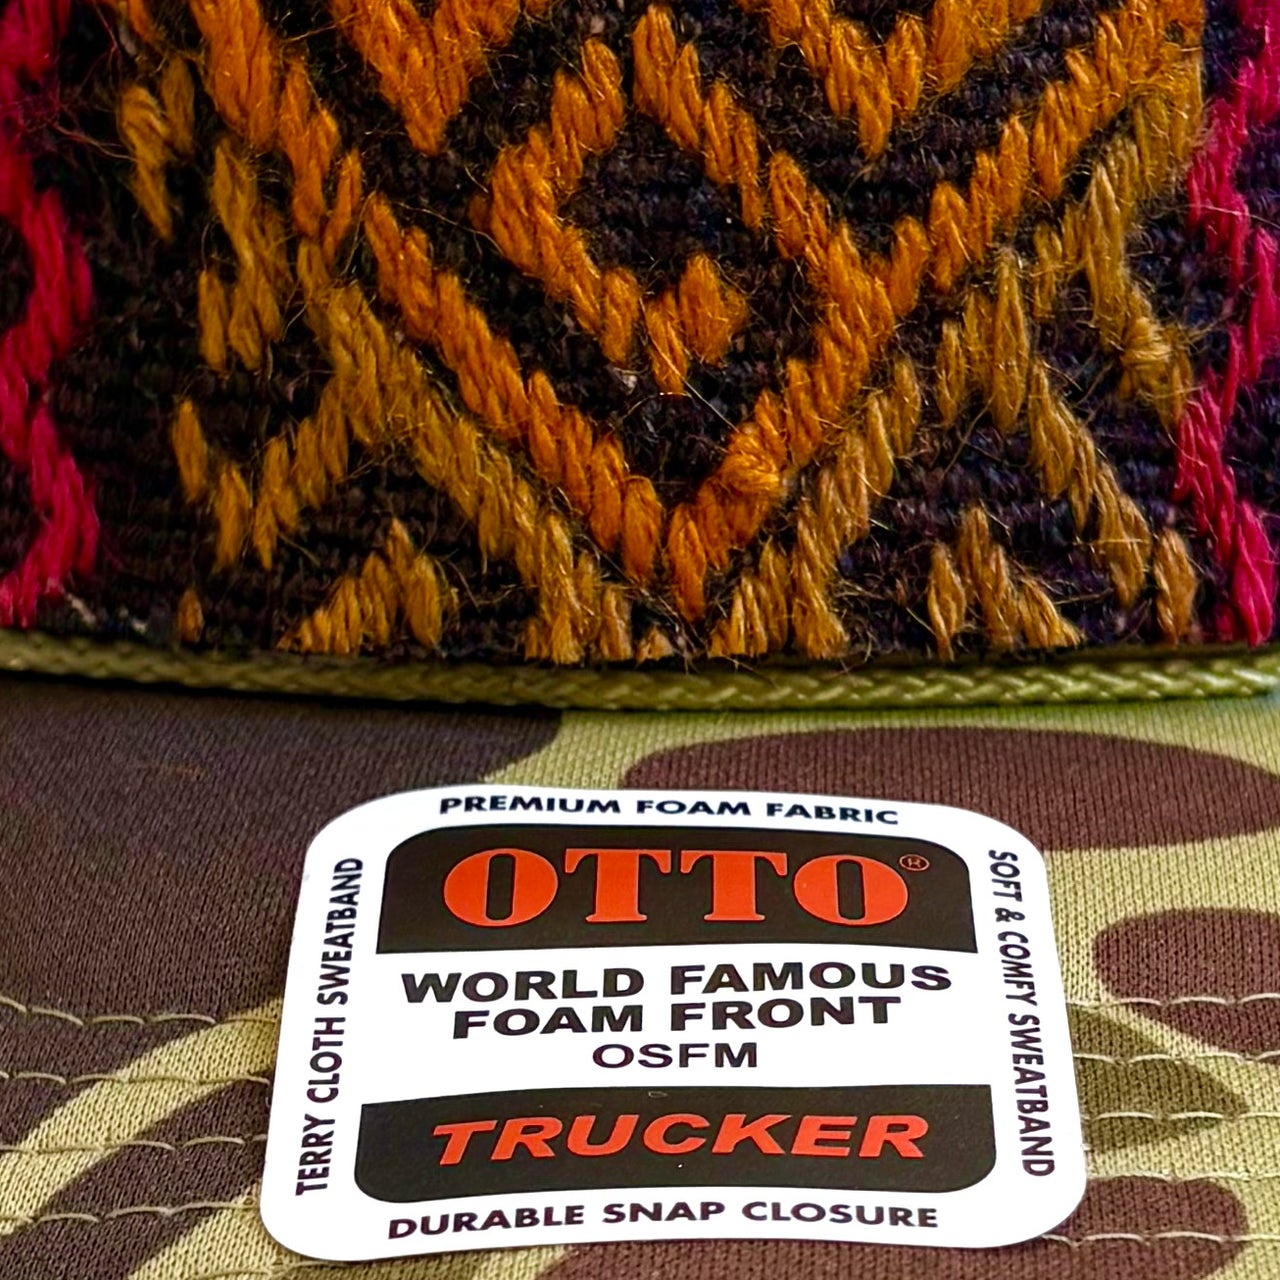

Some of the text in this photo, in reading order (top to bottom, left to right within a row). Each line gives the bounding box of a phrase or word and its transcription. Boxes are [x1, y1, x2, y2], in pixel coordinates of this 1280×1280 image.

[440, 796, 899, 825] PREMIUM FOAM FABRIC
[401, 962, 951, 1003] WORLD FAMOUS
[295, 857, 364, 1197] TERRY CLOTH SWEATBAND
[453, 996, 901, 1039] FOAM FRONT
[988, 849, 1055, 1176] SOFT & COMFY SWEATBAND
[593, 1042, 757, 1068] OSFM
[433, 1114, 928, 1165] TRUCKER
[387, 1202, 937, 1240] DURABLE SNAP CLOSURE
